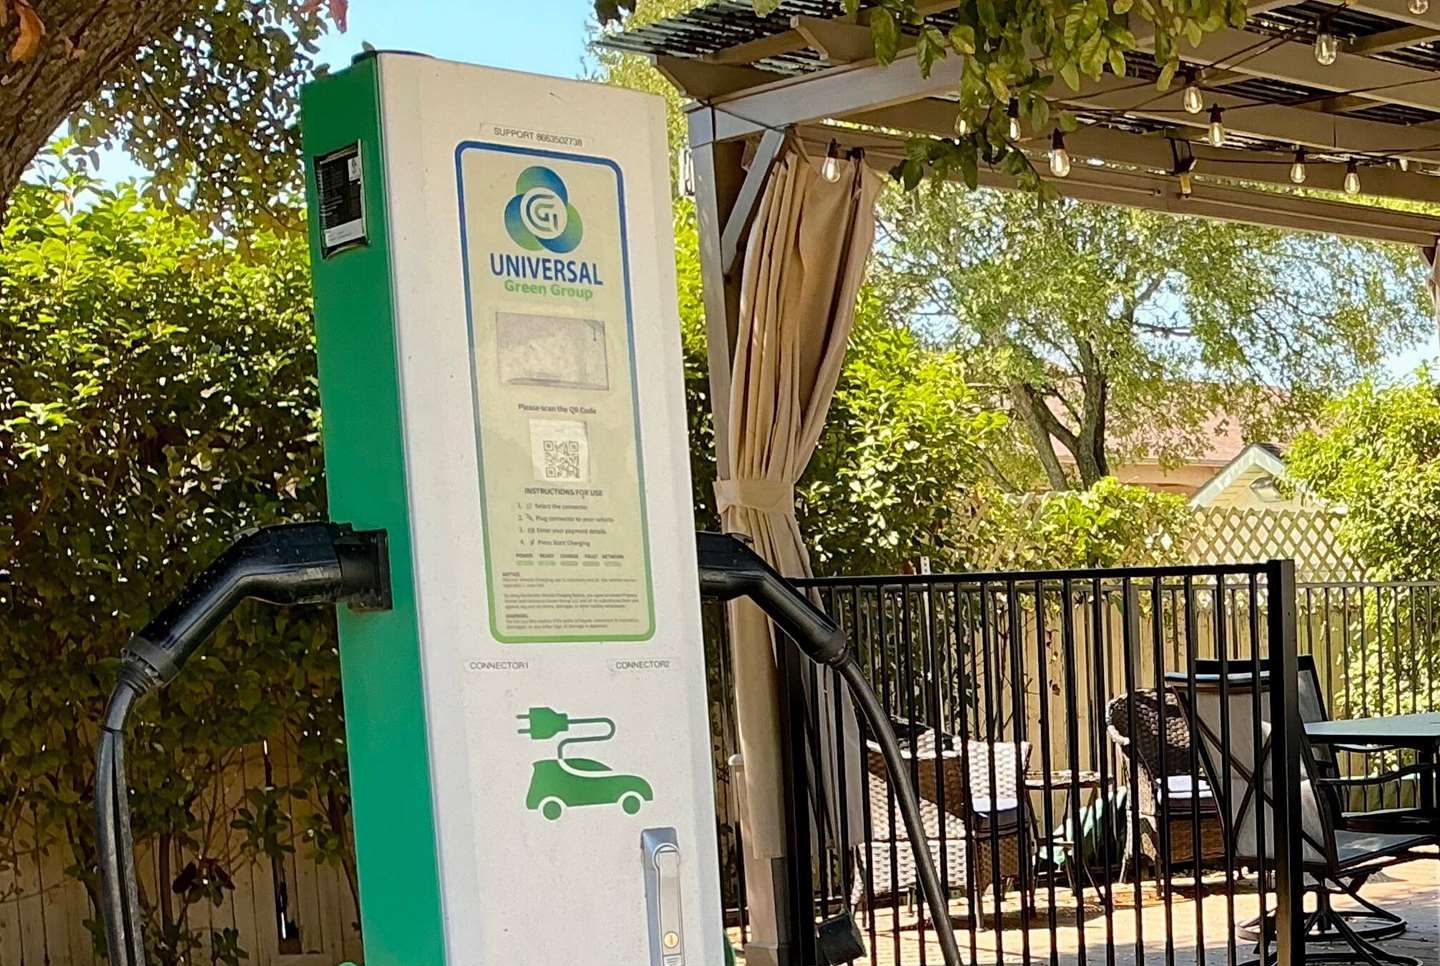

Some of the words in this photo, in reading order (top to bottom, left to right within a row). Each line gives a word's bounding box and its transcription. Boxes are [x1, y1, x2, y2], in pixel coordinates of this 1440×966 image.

[494, 127, 534, 140] SUPPORT
[490, 252, 604, 286] UNIVERSAL
[504, 279, 547, 297] Green
[550, 283, 594, 301] Group
